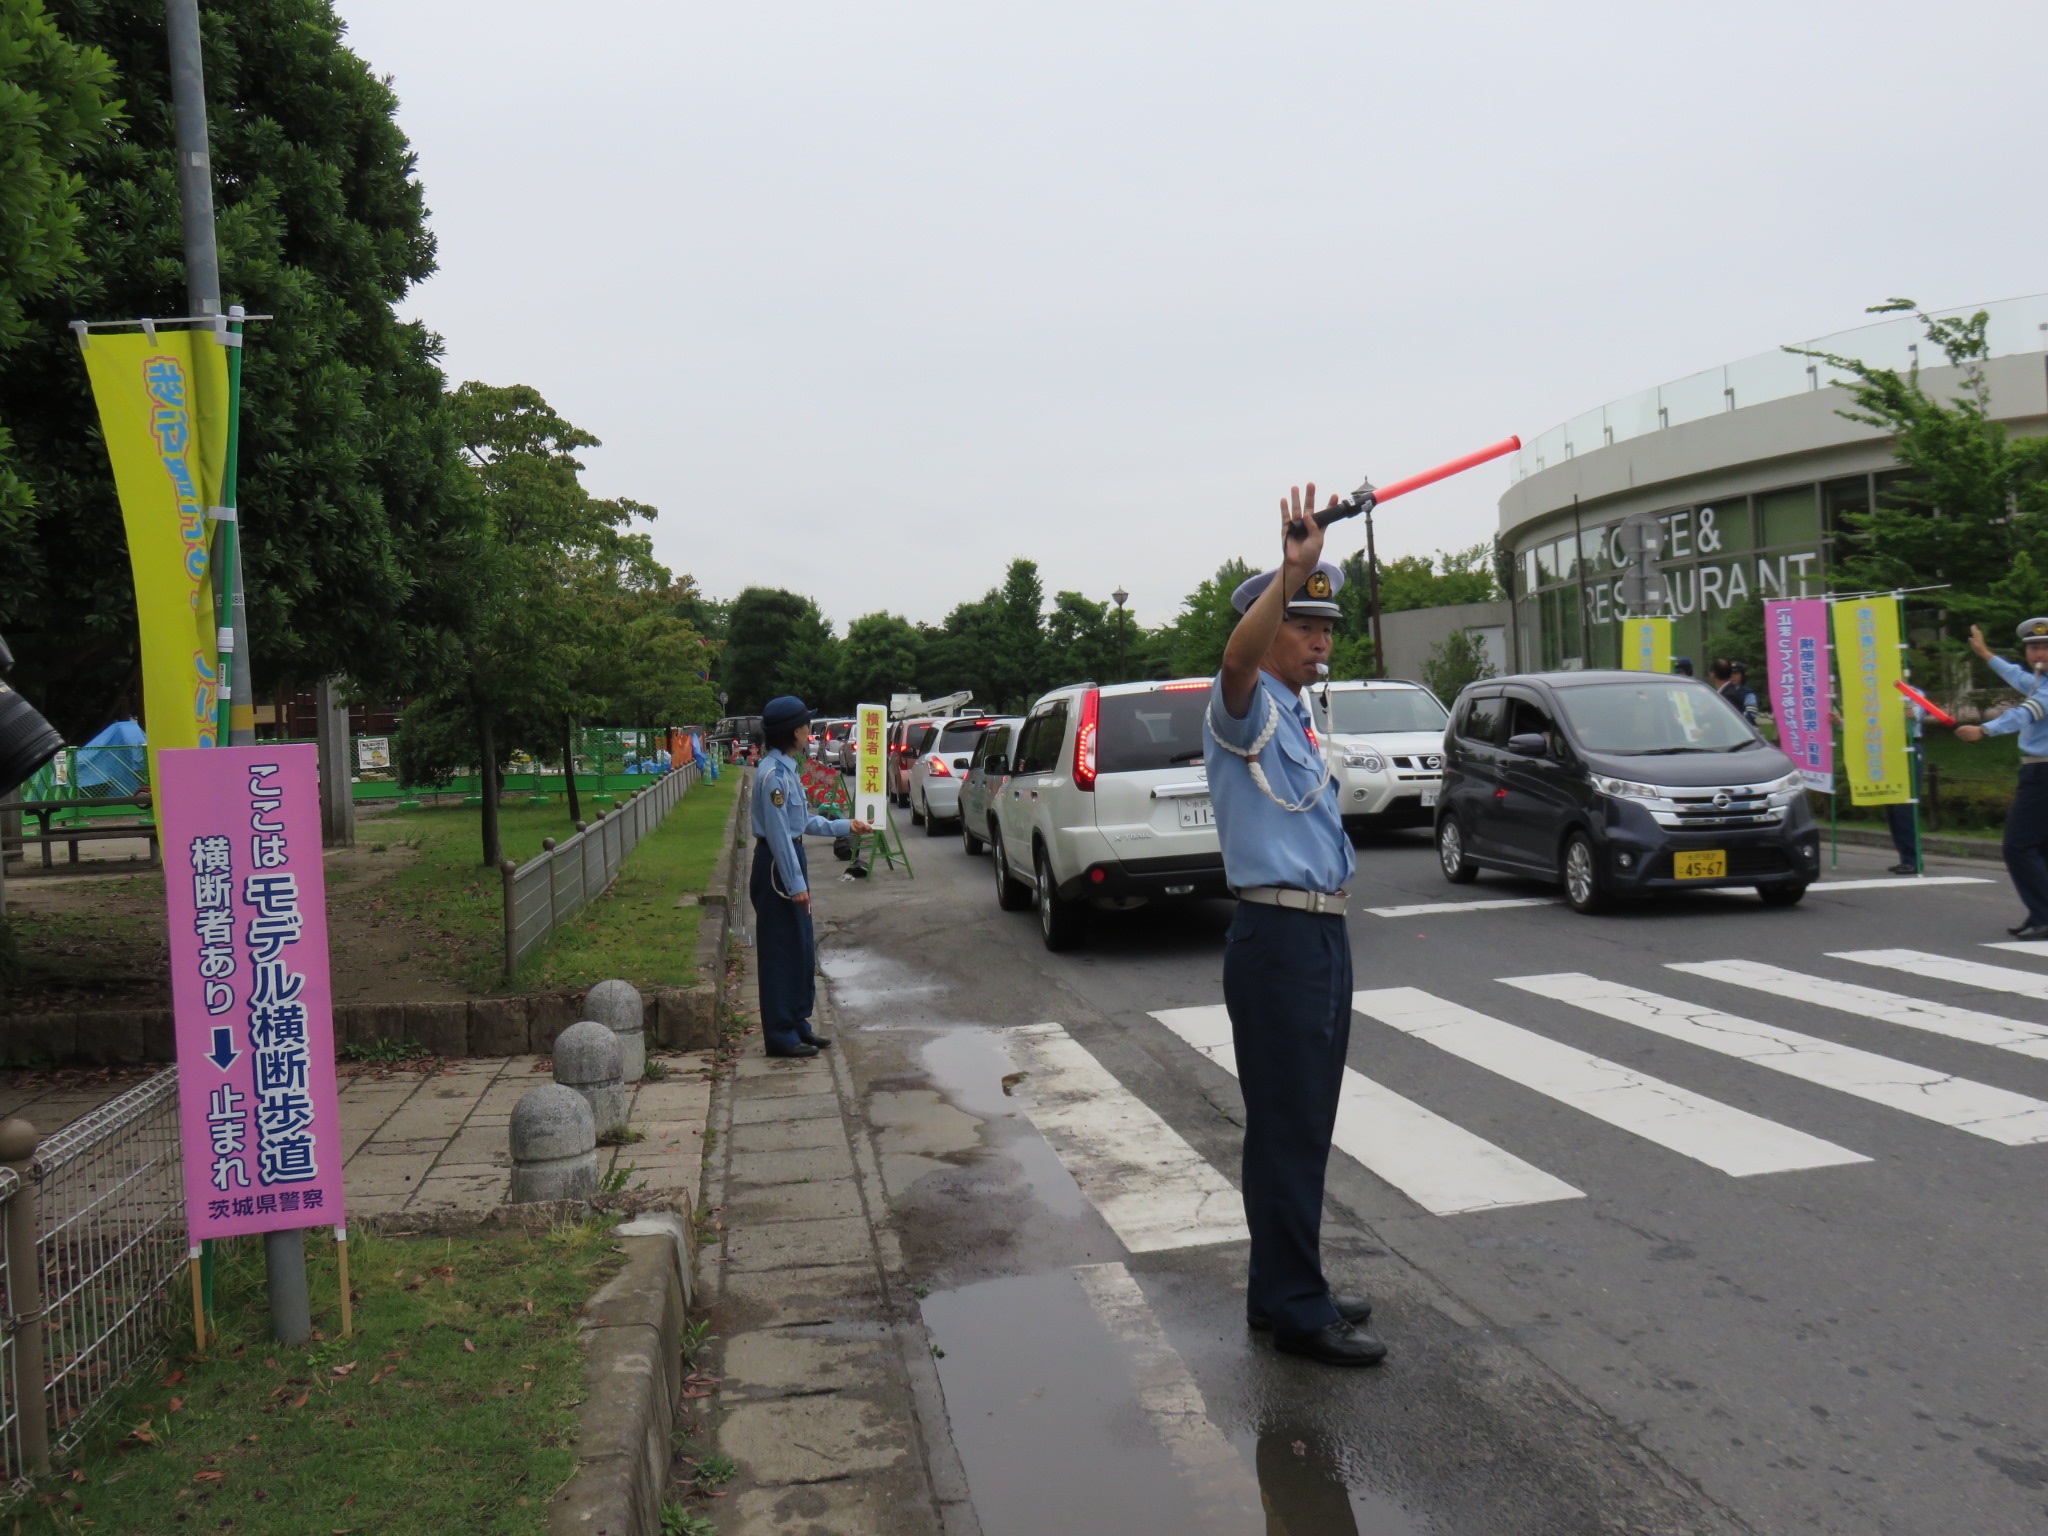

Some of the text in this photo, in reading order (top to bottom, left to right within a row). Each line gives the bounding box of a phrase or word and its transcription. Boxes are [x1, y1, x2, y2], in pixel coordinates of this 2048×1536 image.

[1583, 552, 1816, 625] RESAURANT
[865, 712, 879, 793] 横断者 守れ
[1114, 832, 1153, 842] X-TRAIL
[1686, 862, 1723, 877] 45-67
[244, 763, 318, 1186] ここはモデル横断歩道
[191, 836, 251, 1192] 横断者あり 止まれ
[208, 1188, 324, 1220] 茨城県警察
